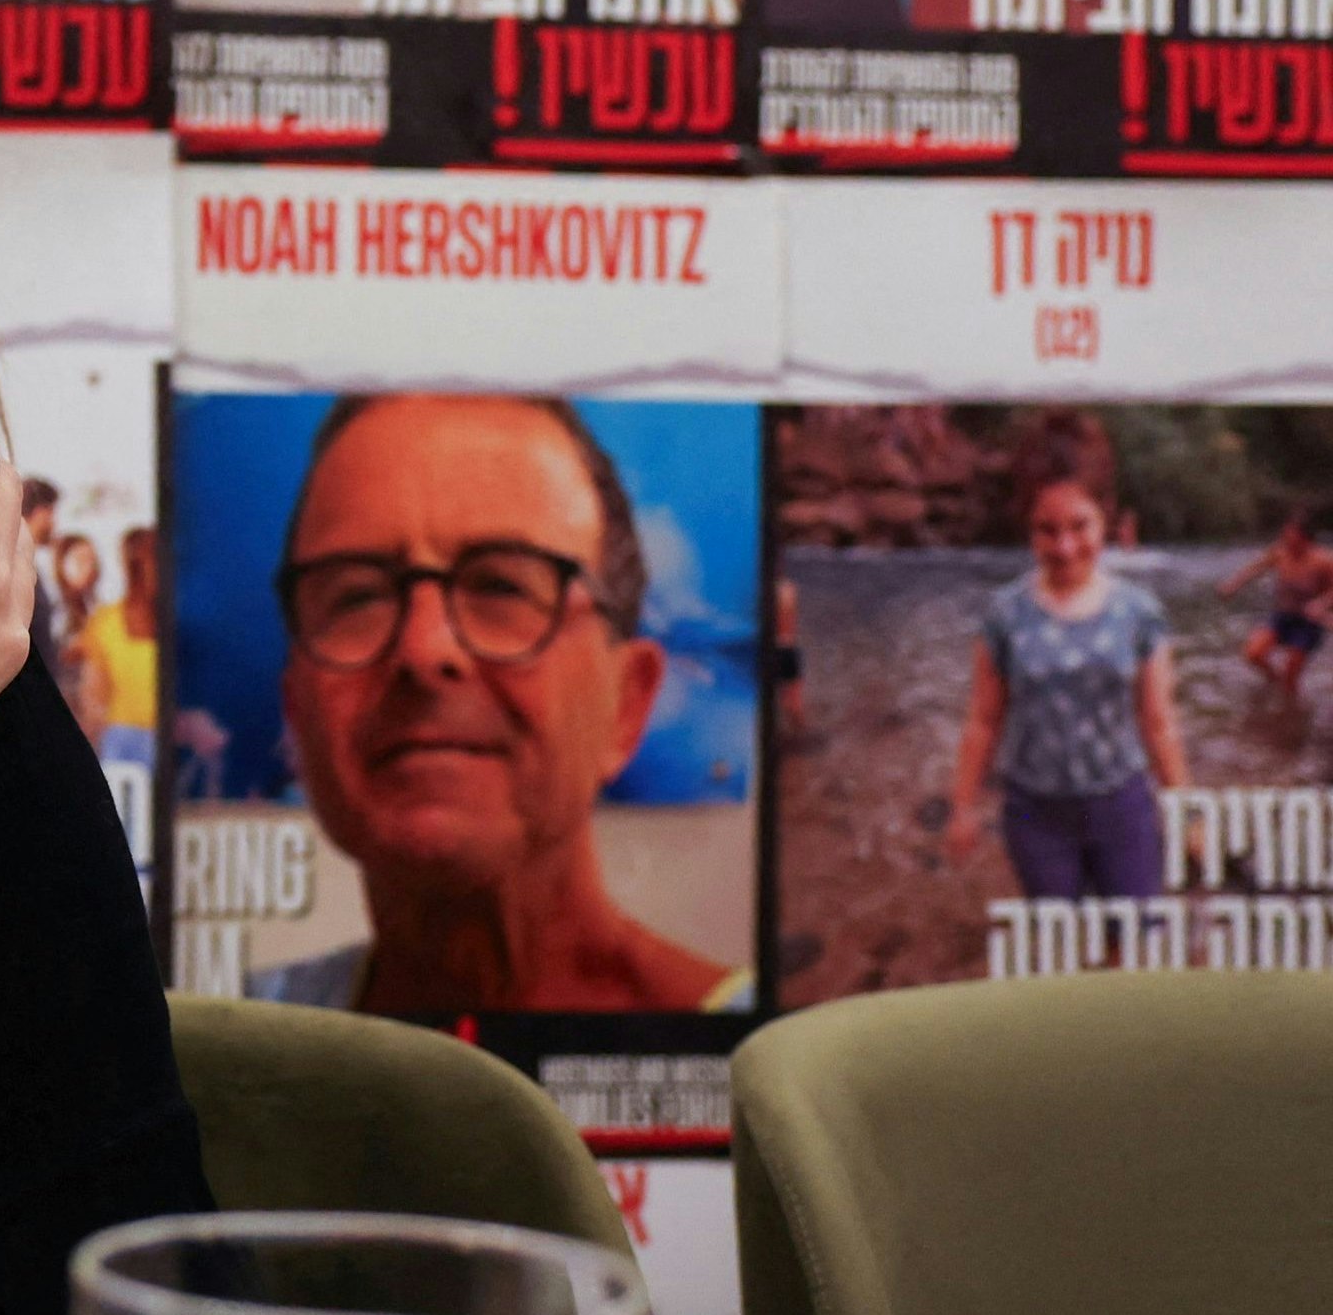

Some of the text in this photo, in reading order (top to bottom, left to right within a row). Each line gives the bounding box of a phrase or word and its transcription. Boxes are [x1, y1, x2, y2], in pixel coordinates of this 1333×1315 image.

[491, 16, 734, 132] עכשיו!
[196, 194, 709, 287] NOAH HERSHKOVITZ
[173, 820, 310, 913] RING
[1157, 785, 1333, 890] חזירו
[173, 920, 242, 1000] IM
[1206, 895, 1333, 972] ותה
